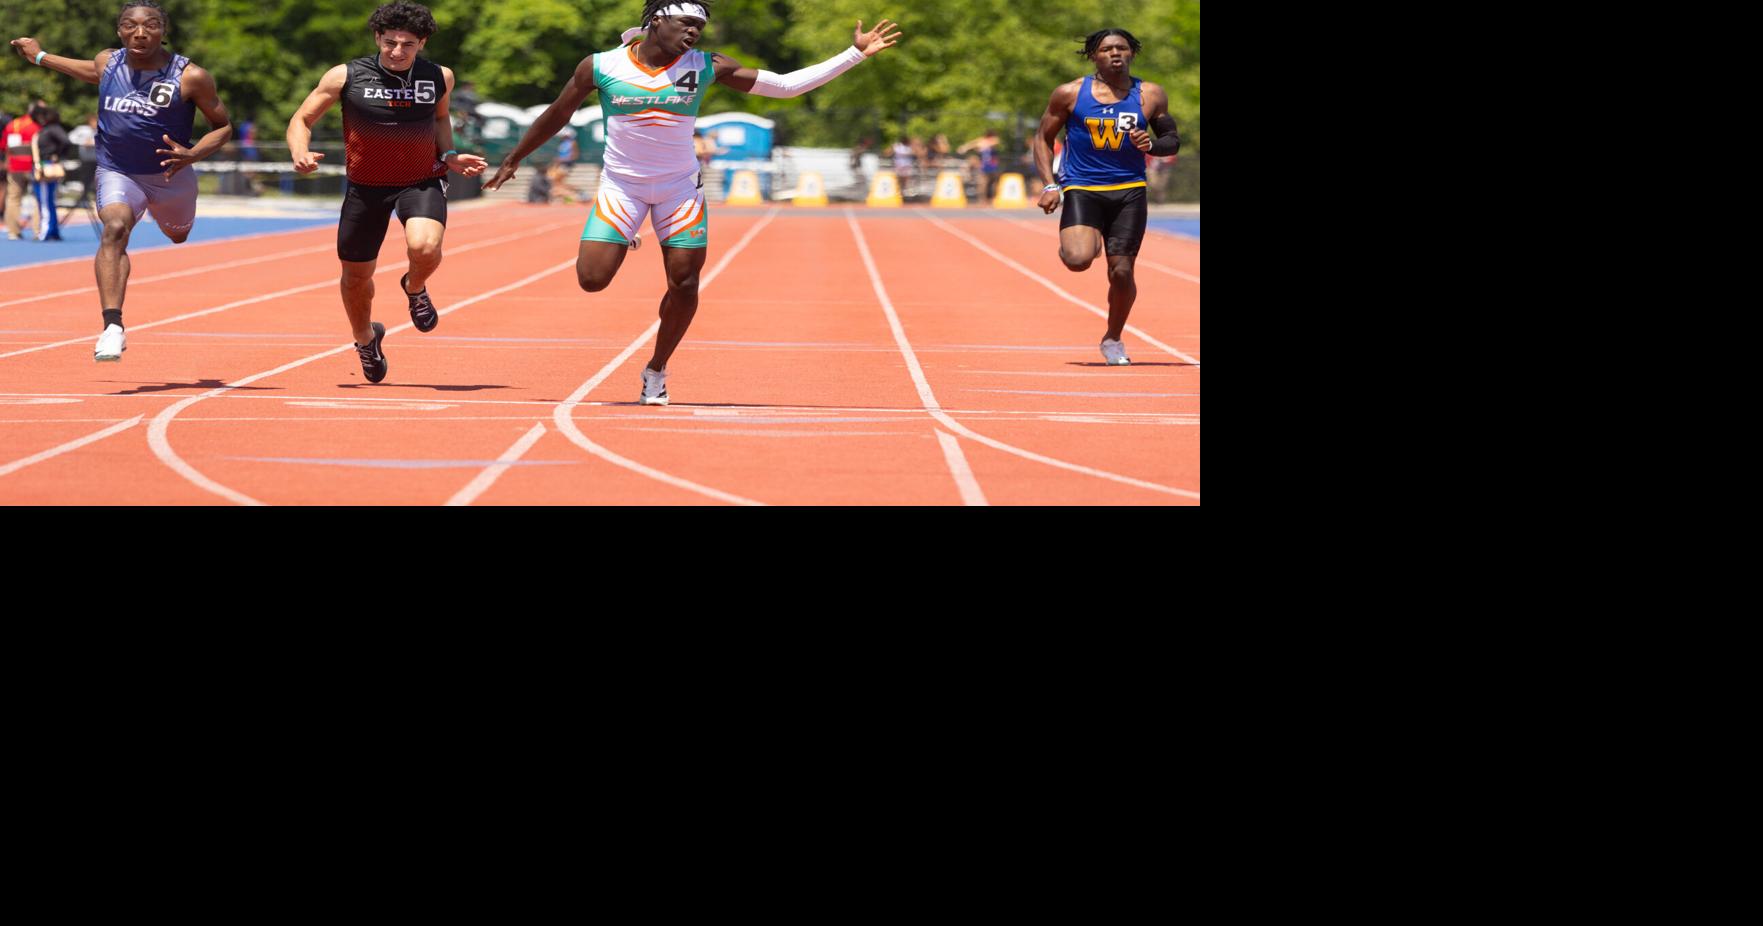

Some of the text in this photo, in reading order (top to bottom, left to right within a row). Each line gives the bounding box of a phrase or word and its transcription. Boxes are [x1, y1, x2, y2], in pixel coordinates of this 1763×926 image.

[675, 70, 698, 92] 4
[150, 85, 172, 106] 6
[363, 87, 416, 99] EASTE
[416, 82, 434, 102] 5
[611, 94, 697, 106] WESTLAKE
[104, 96, 158, 117] LIONS
[1119, 114, 1136, 131] 3
[1084, 116, 1126, 151] W
